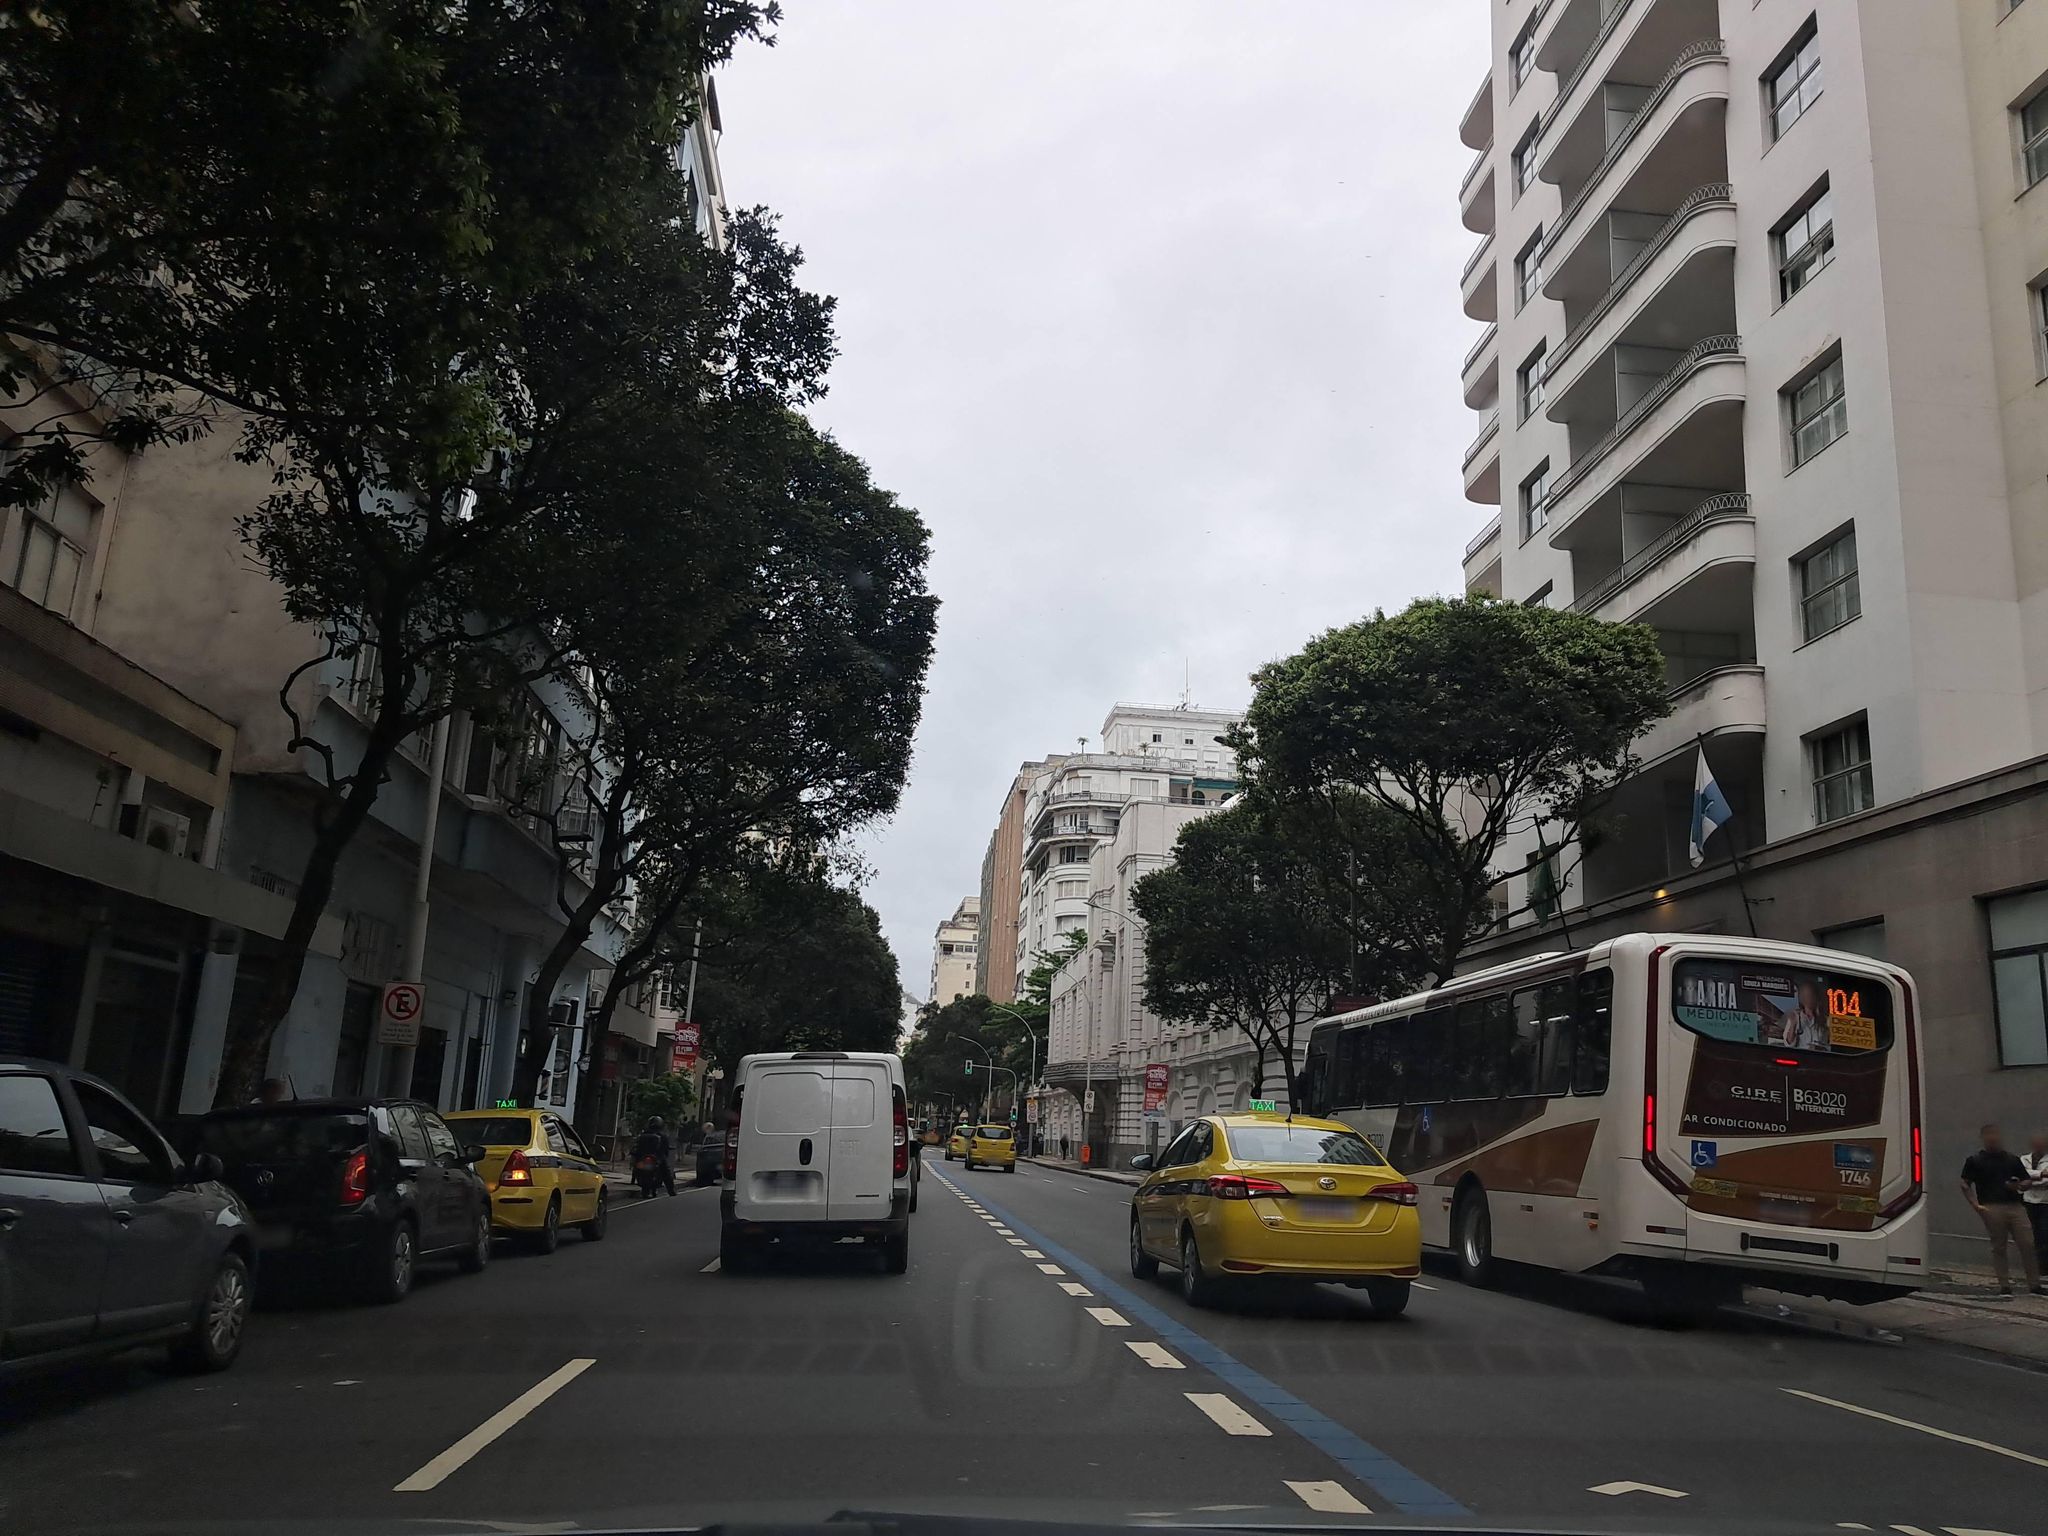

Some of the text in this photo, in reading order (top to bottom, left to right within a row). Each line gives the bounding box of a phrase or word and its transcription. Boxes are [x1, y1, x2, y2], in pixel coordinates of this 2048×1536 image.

[1827, 988, 1862, 1018] 104
[1686, 1007, 1751, 1023] MEDICINA
[1831, 1016, 1873, 1029] DISQUE
[1730, 1085, 1783, 1100] GIRE
[1793, 1088, 1847, 1108] B63020
[495, 1099, 517, 1109] TAXI
[1250, 1100, 1275, 1111] TAXI
[1795, 1103, 1846, 1116] INTERNORTE
[1683, 1114, 1787, 1133] AR CONDICIONADO
[1839, 1169, 1873, 1186] 1746
